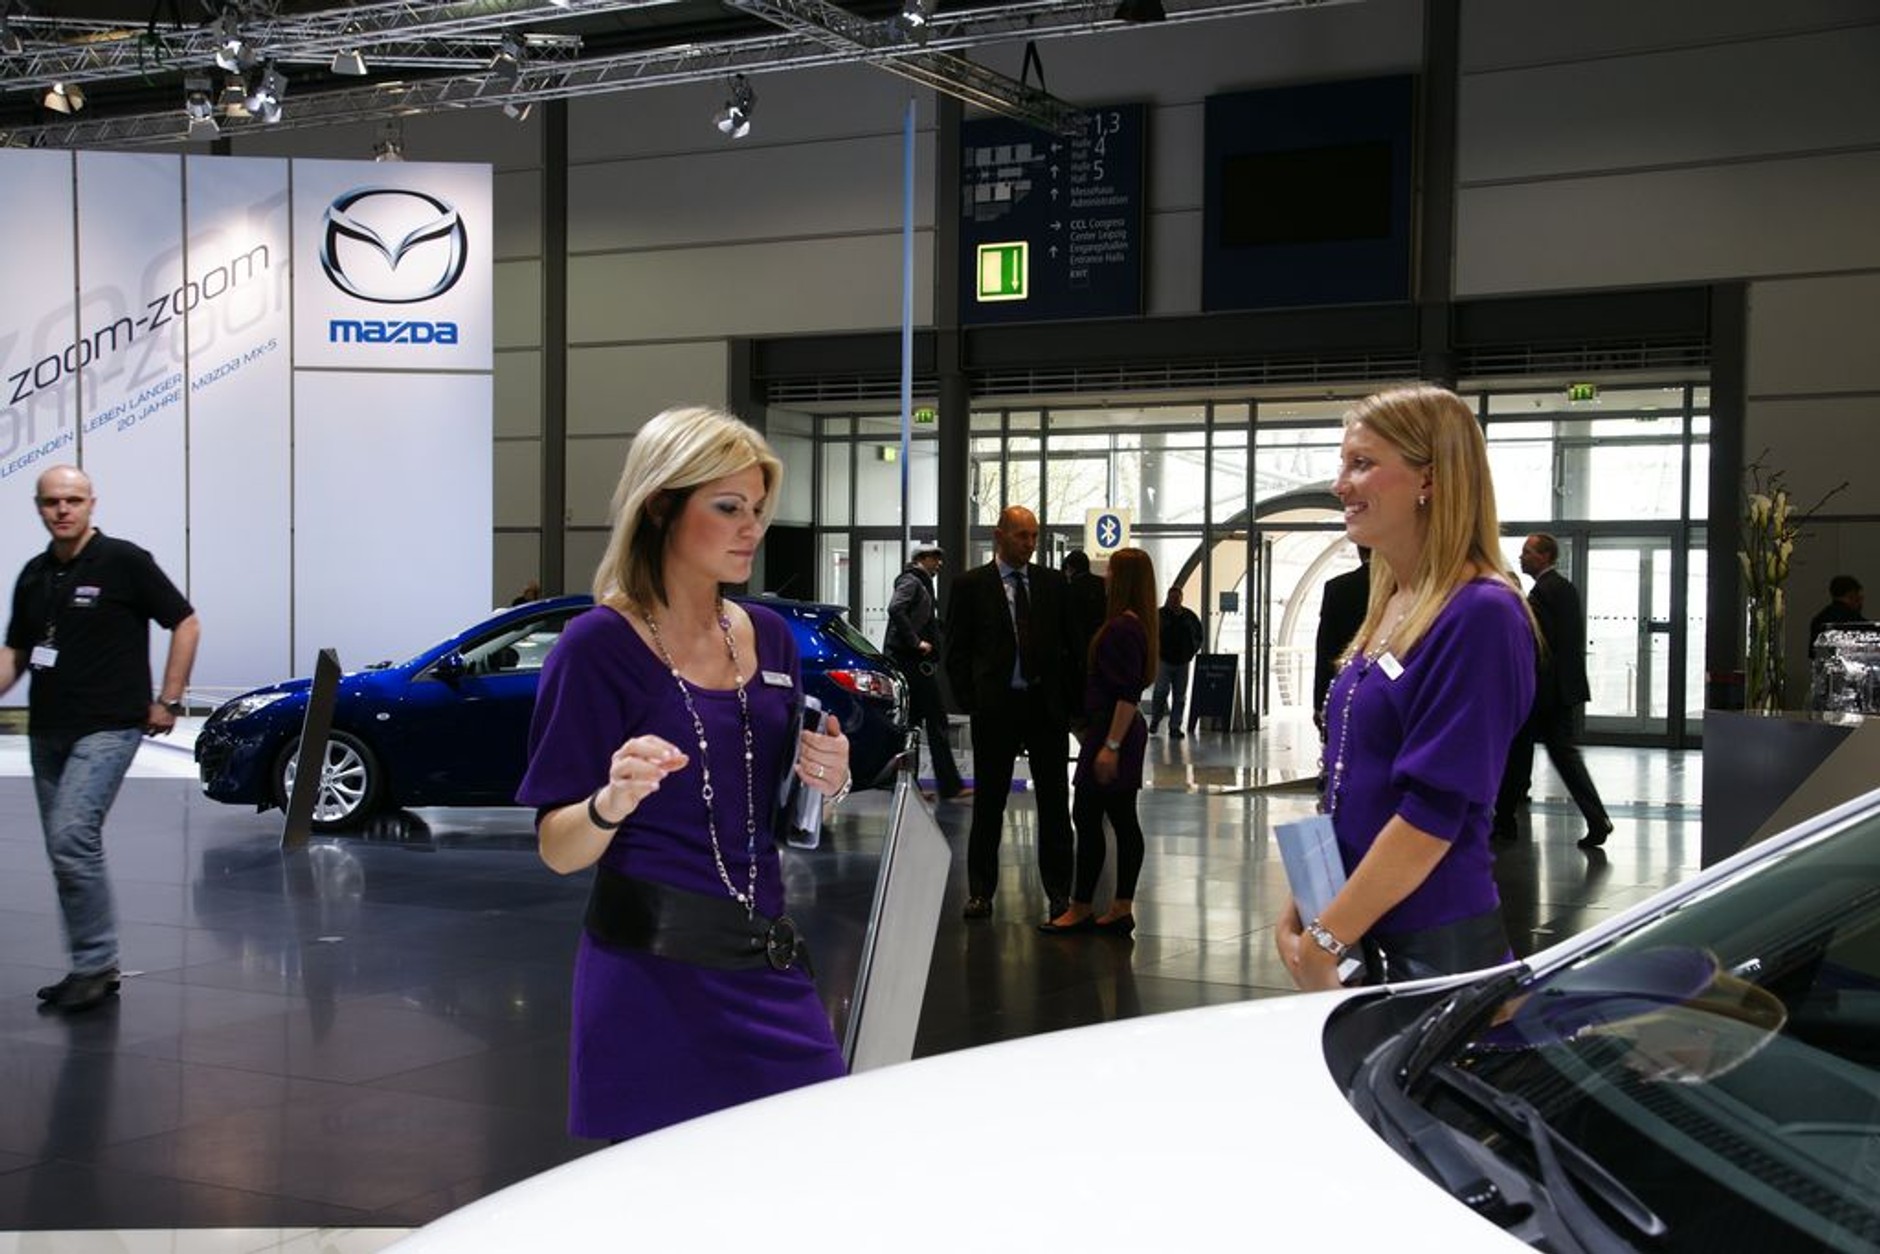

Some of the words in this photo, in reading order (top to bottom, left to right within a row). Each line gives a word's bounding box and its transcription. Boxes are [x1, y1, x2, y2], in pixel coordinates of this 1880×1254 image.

[1094, 137, 1105, 156] 4
[1093, 160, 1104, 180] 5
[1070, 220, 1087, 230] CCL
[8, 244, 269, 406] zoom-zoom
[329, 319, 458, 345] mazda
[117, 414, 136, 432] 20
[139, 392, 182, 420] JAHRE
[1, 431, 74, 479] LEGENDEN
[83, 403, 127, 434] LEBEN
